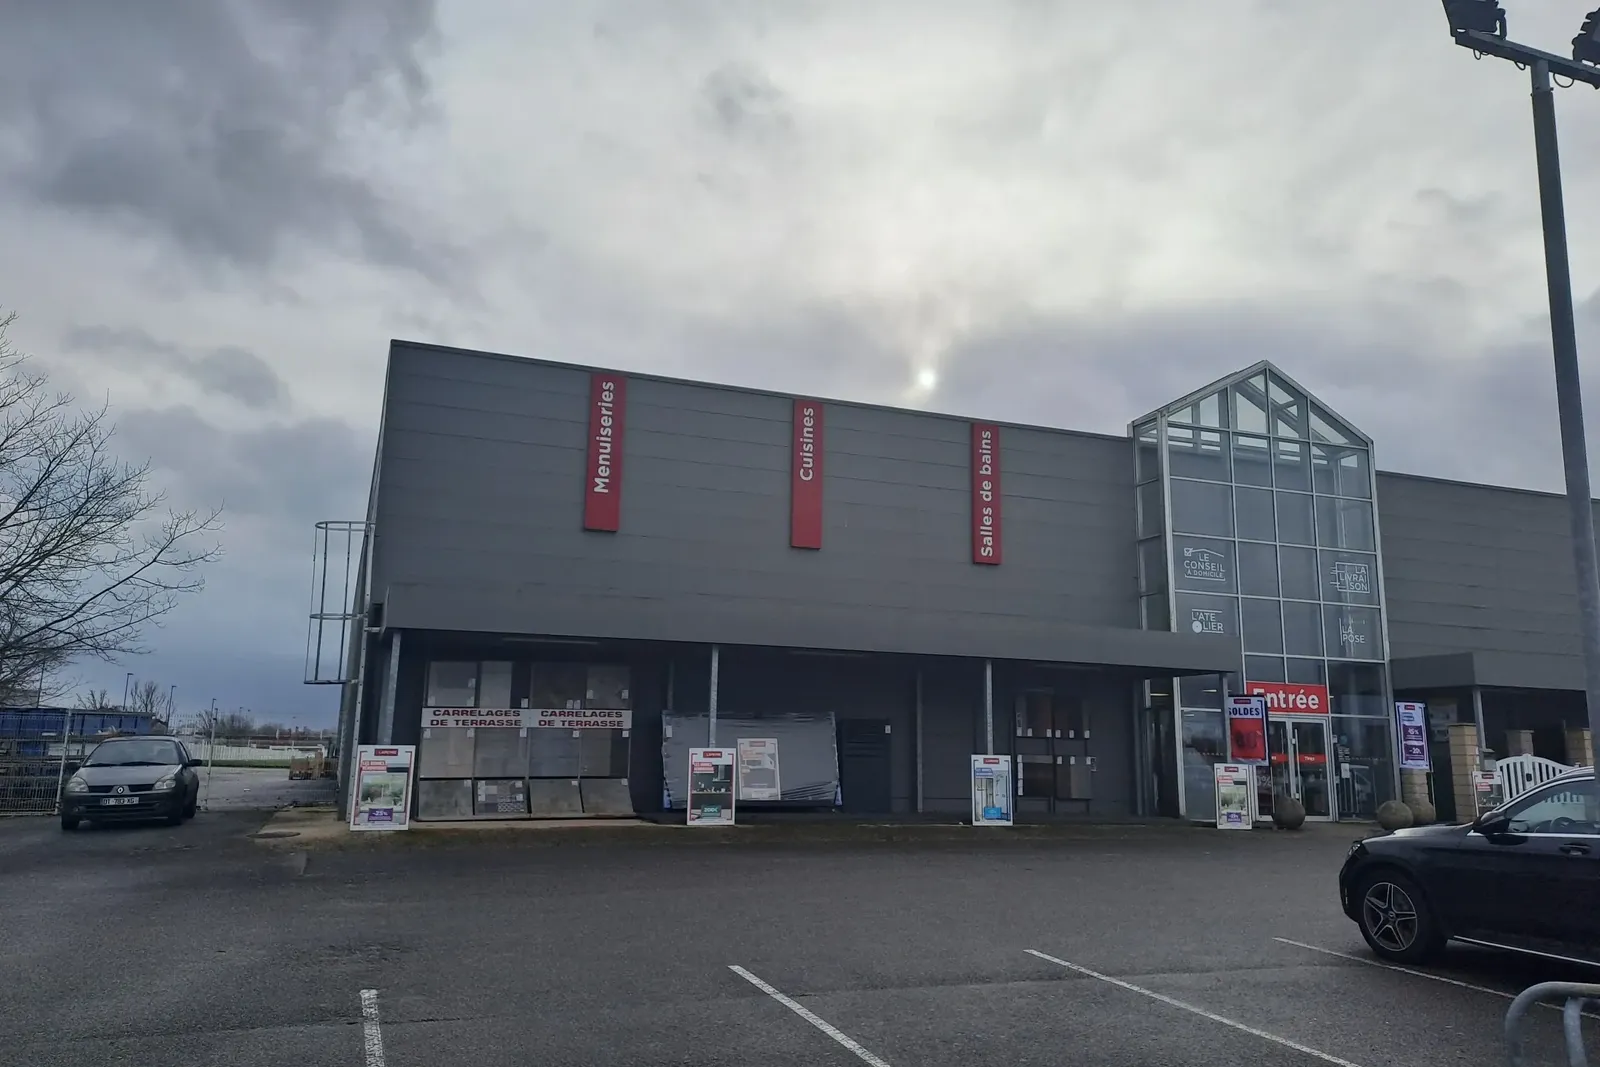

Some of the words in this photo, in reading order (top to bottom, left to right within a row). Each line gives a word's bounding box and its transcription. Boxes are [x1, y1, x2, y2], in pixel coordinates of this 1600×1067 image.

[593, 381, 614, 493] Menuiseries
[799, 408, 814, 481] Cuisines
[979, 430, 991, 475] bains
[980, 480, 992, 501] de
[980, 507, 993, 557] Salles
[1198, 553, 1210, 562] LE
[1183, 560, 1226, 572] CONSEIL
[1355, 566, 1366, 574] LA
[1193, 569, 1223, 578] DOMICILE
[1339, 573, 1367, 582] LIVRAI
[1349, 582, 1368, 591] SON
[1191, 611, 1216, 621] L'ATE
[1342, 625, 1353, 634] LA
[1342, 634, 1365, 643] POSE
[432, 709, 521, 717] CARRELAGES
[540, 710, 623, 718] CARRELAGES
[430, 719, 451, 727] DE
[454, 719, 522, 727] TERRASSE
